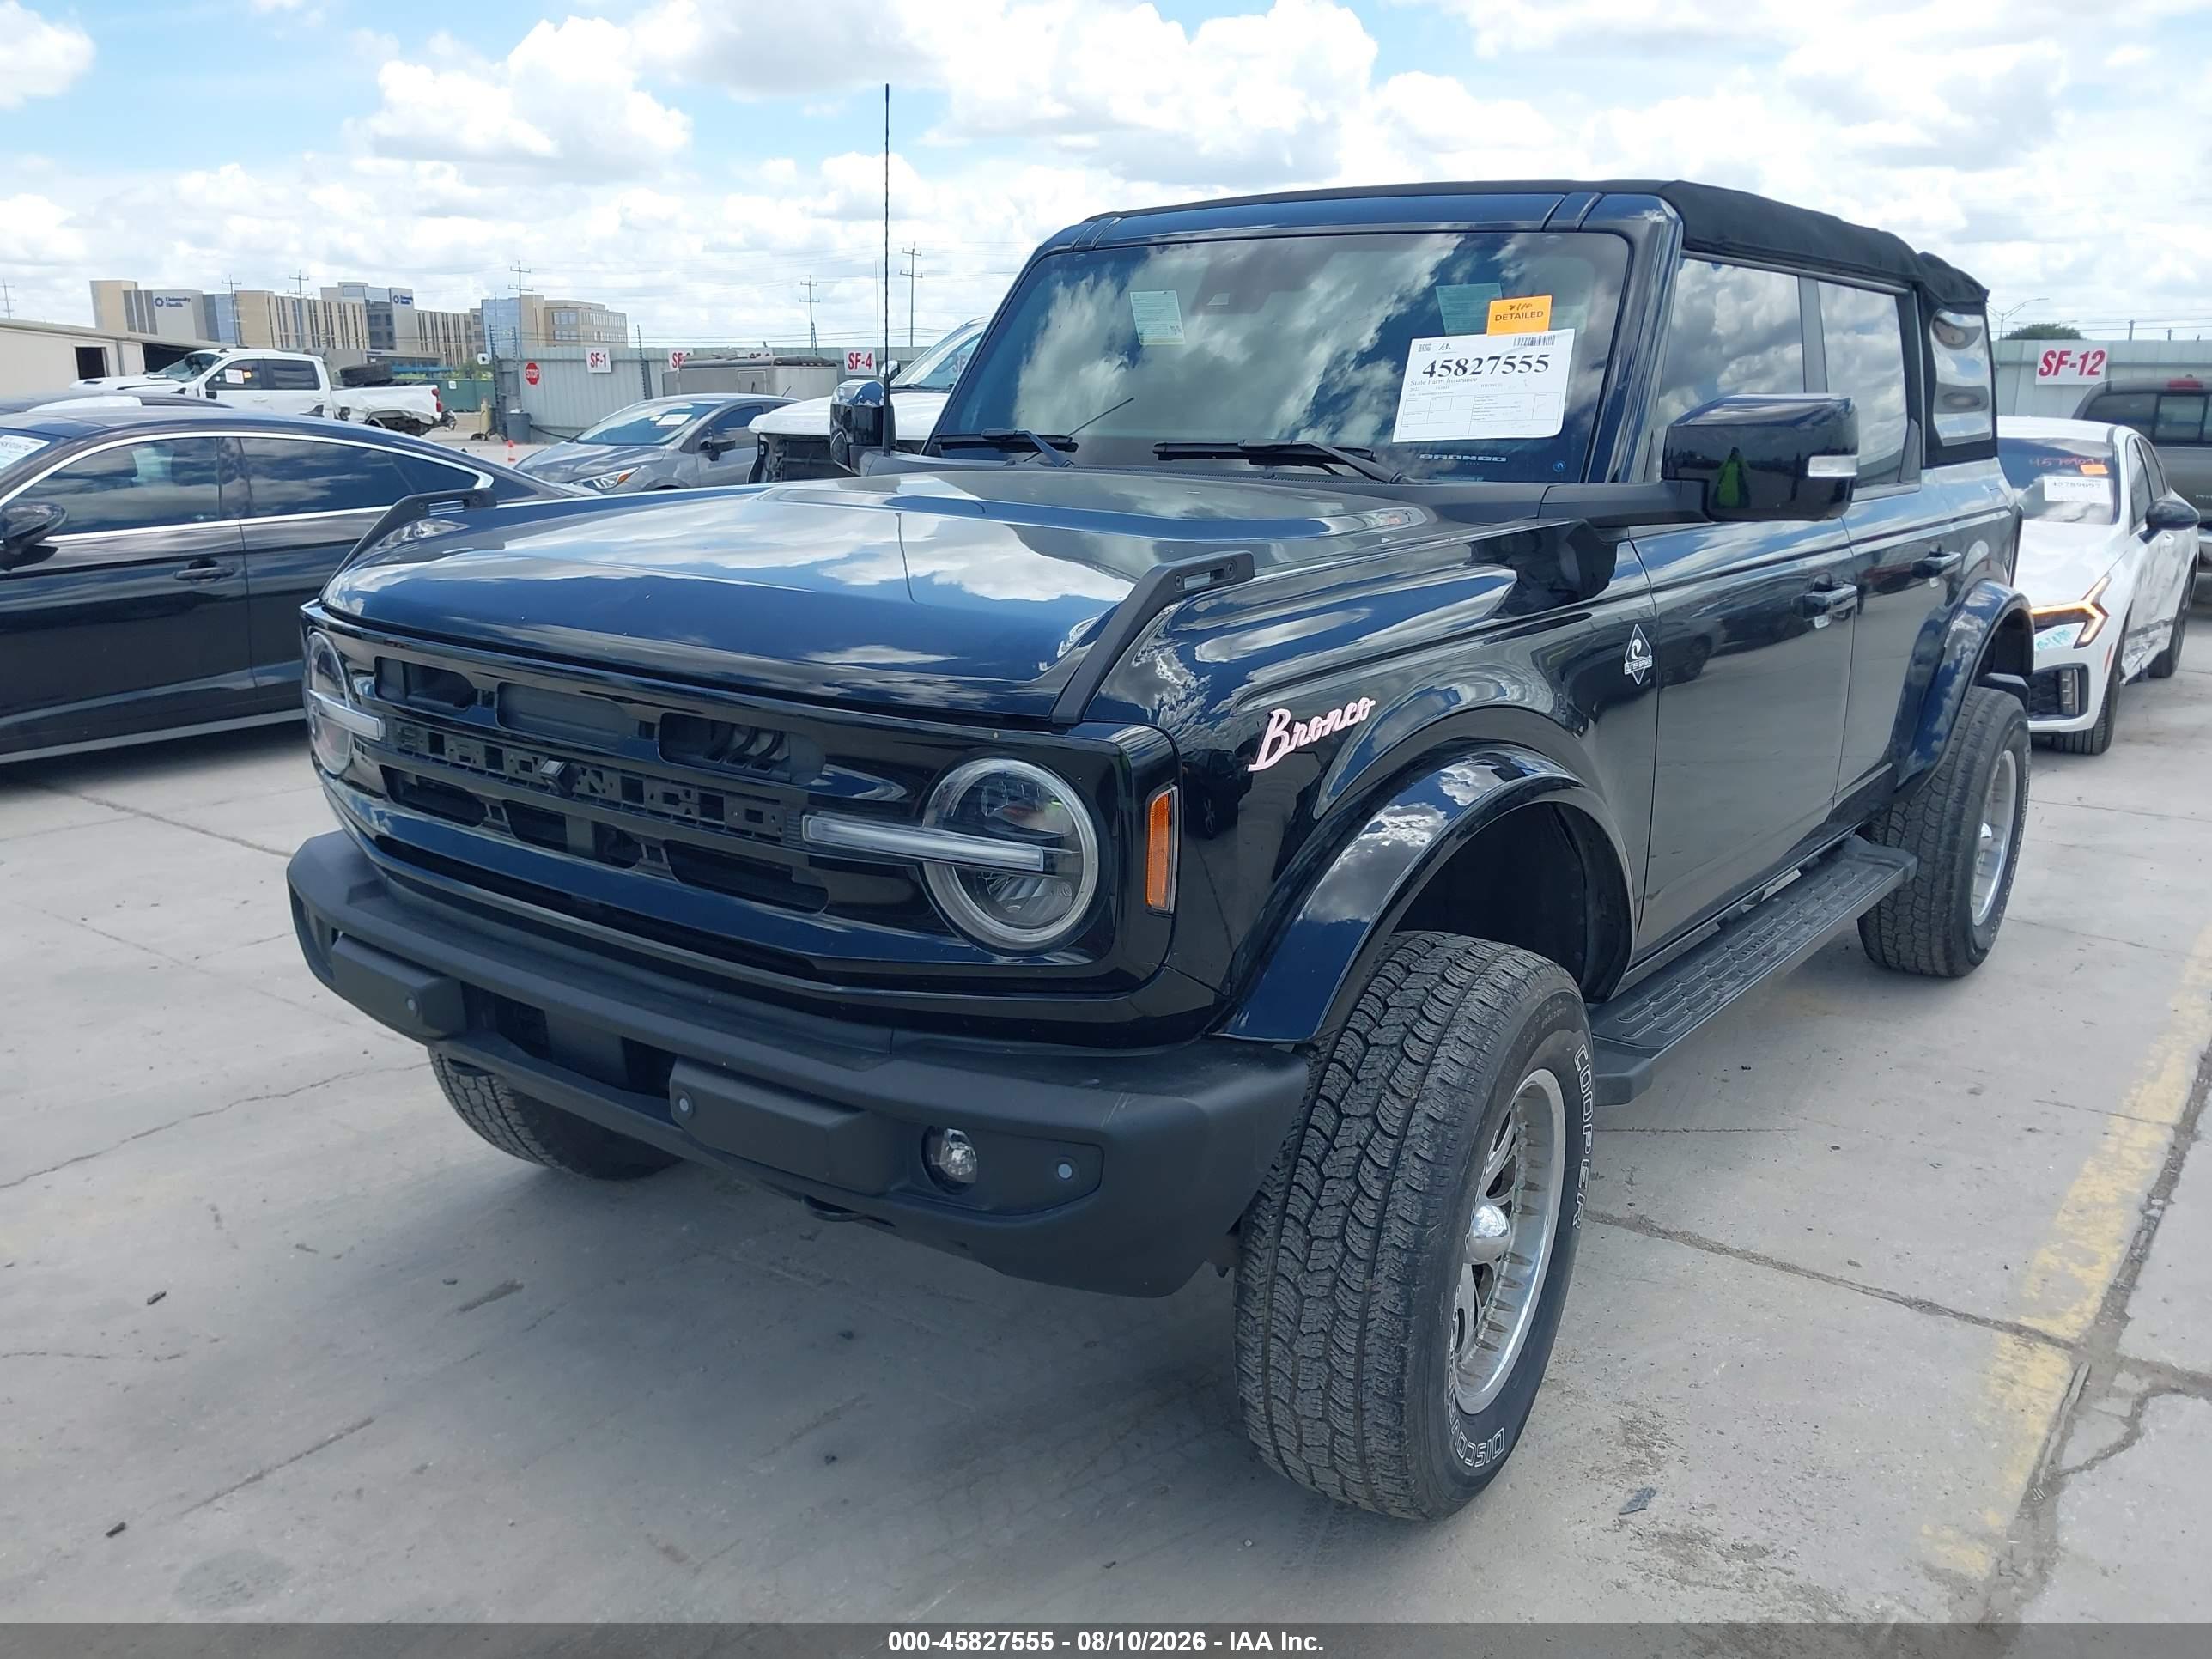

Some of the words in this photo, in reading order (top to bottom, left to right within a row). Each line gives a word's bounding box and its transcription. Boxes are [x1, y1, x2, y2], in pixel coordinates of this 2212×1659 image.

[1495, 310, 1544, 321] DETAILED
[590, 352, 606, 368] SF-1
[672, 353, 690, 368] SF-
[848, 352, 872, 371] SF-4
[1422, 354, 1550, 378] 45827555
[2039, 349, 2106, 377] SF-12
[526, 369, 539, 379] STOP
[1248, 697, 1376, 772] Bronco
[1572, 1043, 1594, 1230] COOPER
